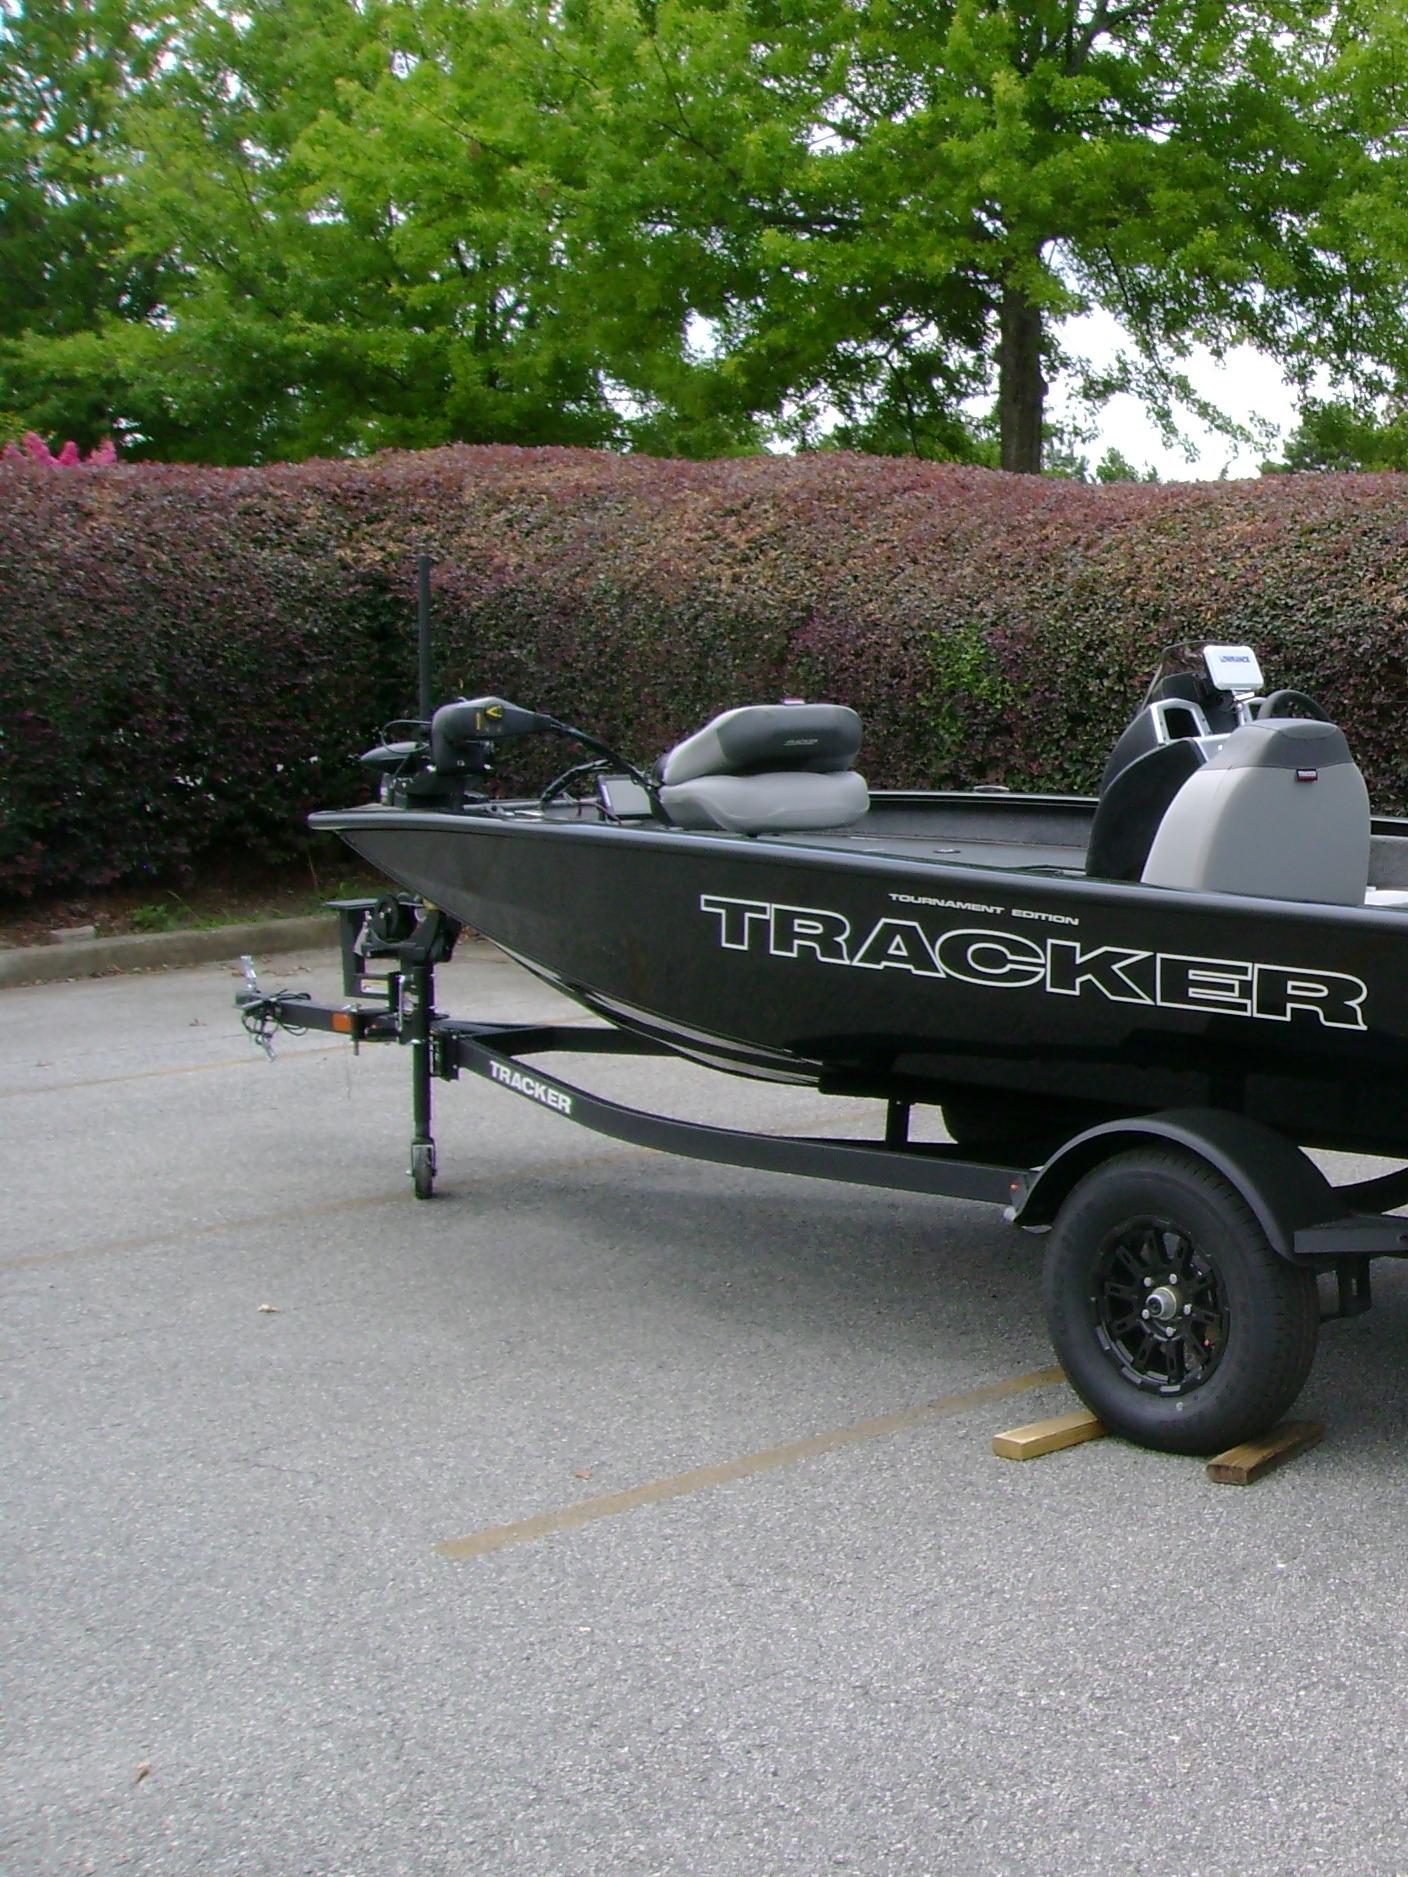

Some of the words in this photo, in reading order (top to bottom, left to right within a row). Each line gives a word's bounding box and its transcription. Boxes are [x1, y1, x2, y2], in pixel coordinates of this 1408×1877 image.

[888, 893, 1005, 914] TOURNAMENT
[1011, 909, 1080, 926] EDITION
[700, 894, 1368, 1031] TRACKER
[489, 1060, 572, 1114] TRACKER
